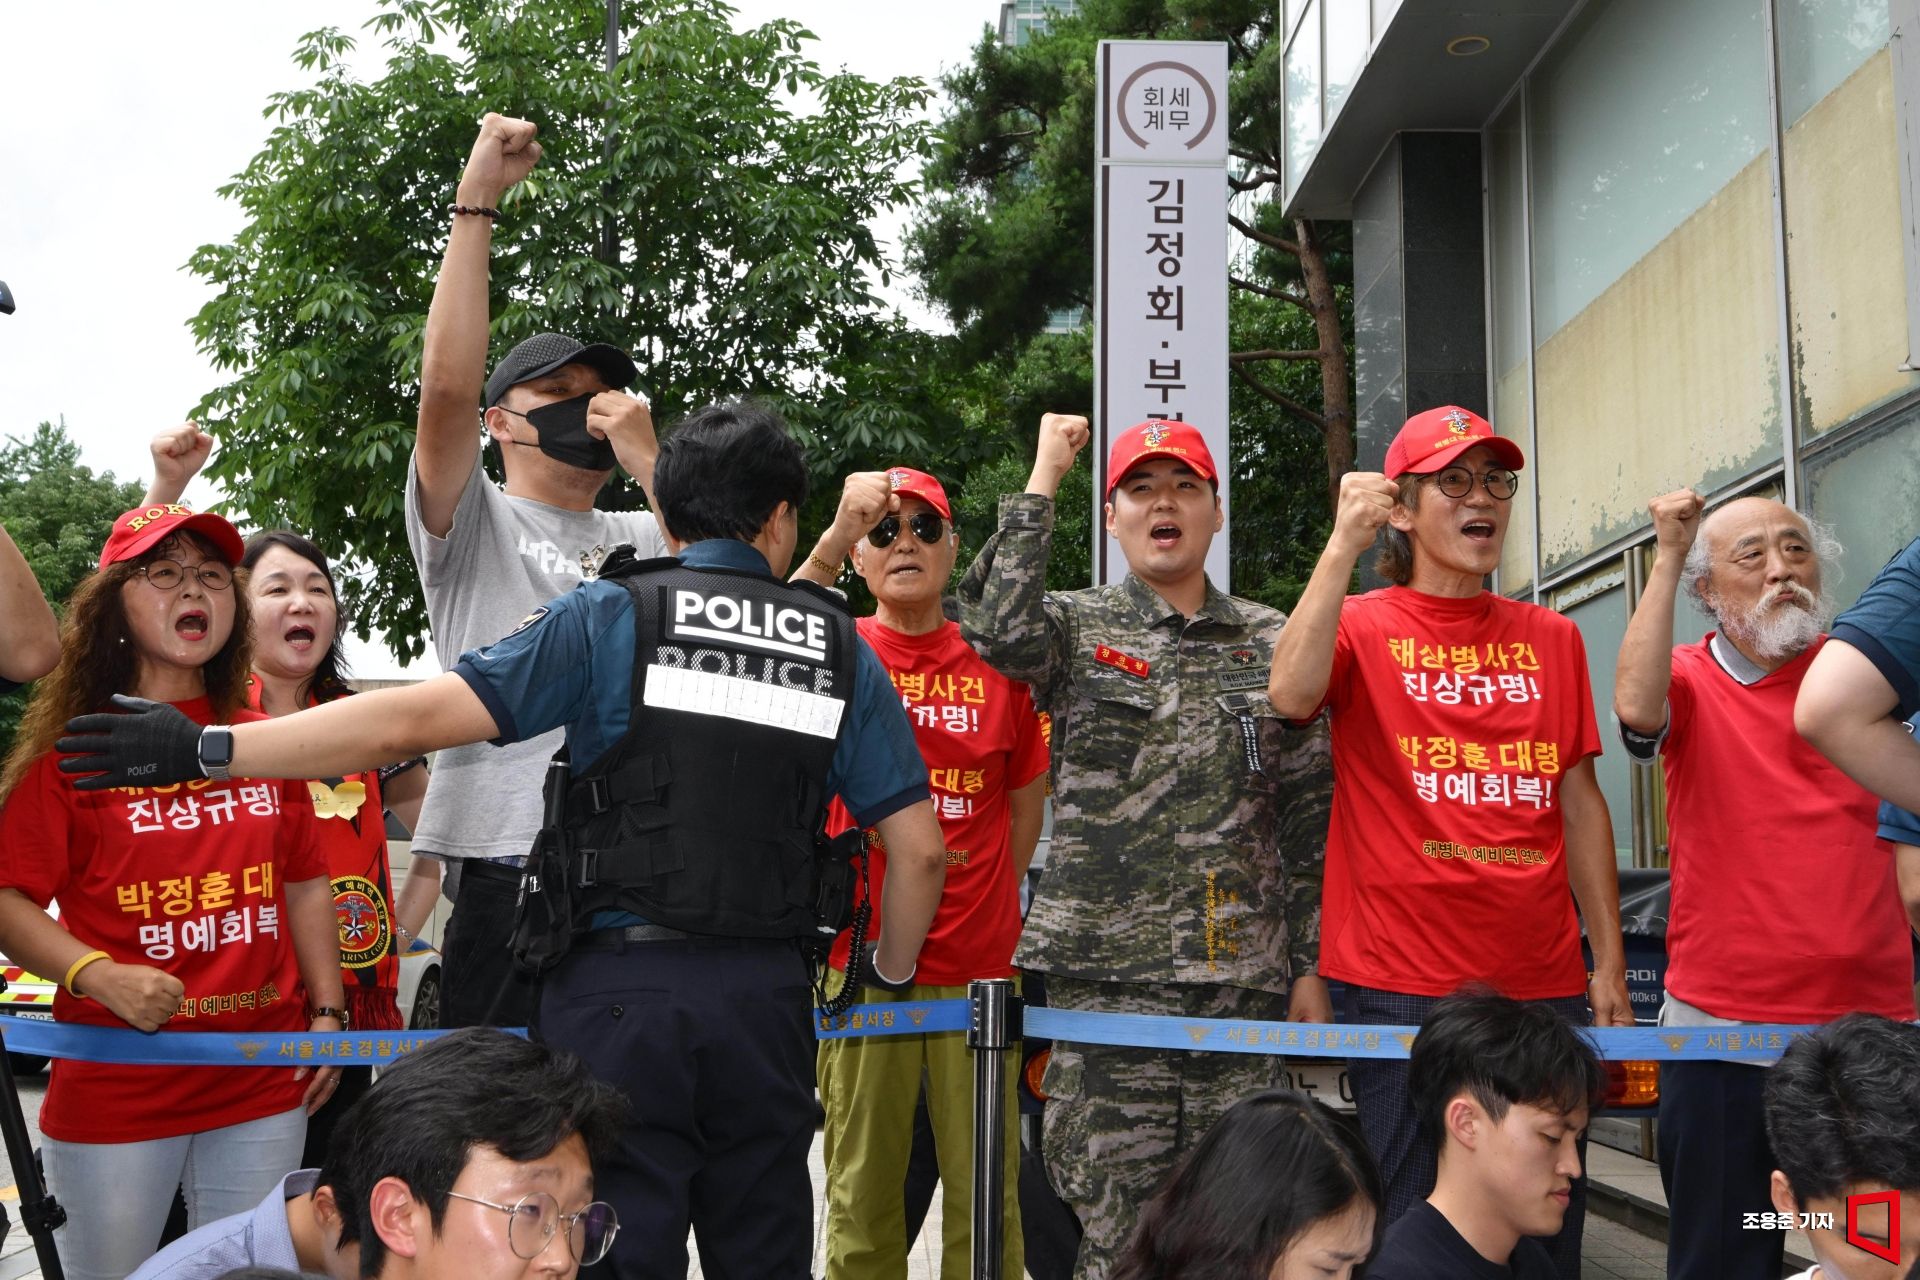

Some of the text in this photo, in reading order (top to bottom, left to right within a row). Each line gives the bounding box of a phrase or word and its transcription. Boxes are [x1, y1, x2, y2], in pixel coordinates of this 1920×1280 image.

[1145, 179, 1186, 420] 김정회·부
[676, 590, 826, 650] POLICE
[1402, 672, 1541, 705] 진상규명!
[127, 763, 158, 776] POLICE
[1397, 733, 1560, 774] 박정훈 대령
[127, 783, 280, 834] 진상규명!
[1412, 770, 1551, 810] 명예회복!
[1423, 840, 1469, 859] 해병대
[1471, 847, 1519, 864] 예비역
[116, 871, 235, 919] 박정훈
[139, 904, 278, 960] 명예회복
[200, 990, 256, 1015] 예비역
[1225, 1027, 1380, 1049] 서울서초경찰서장
